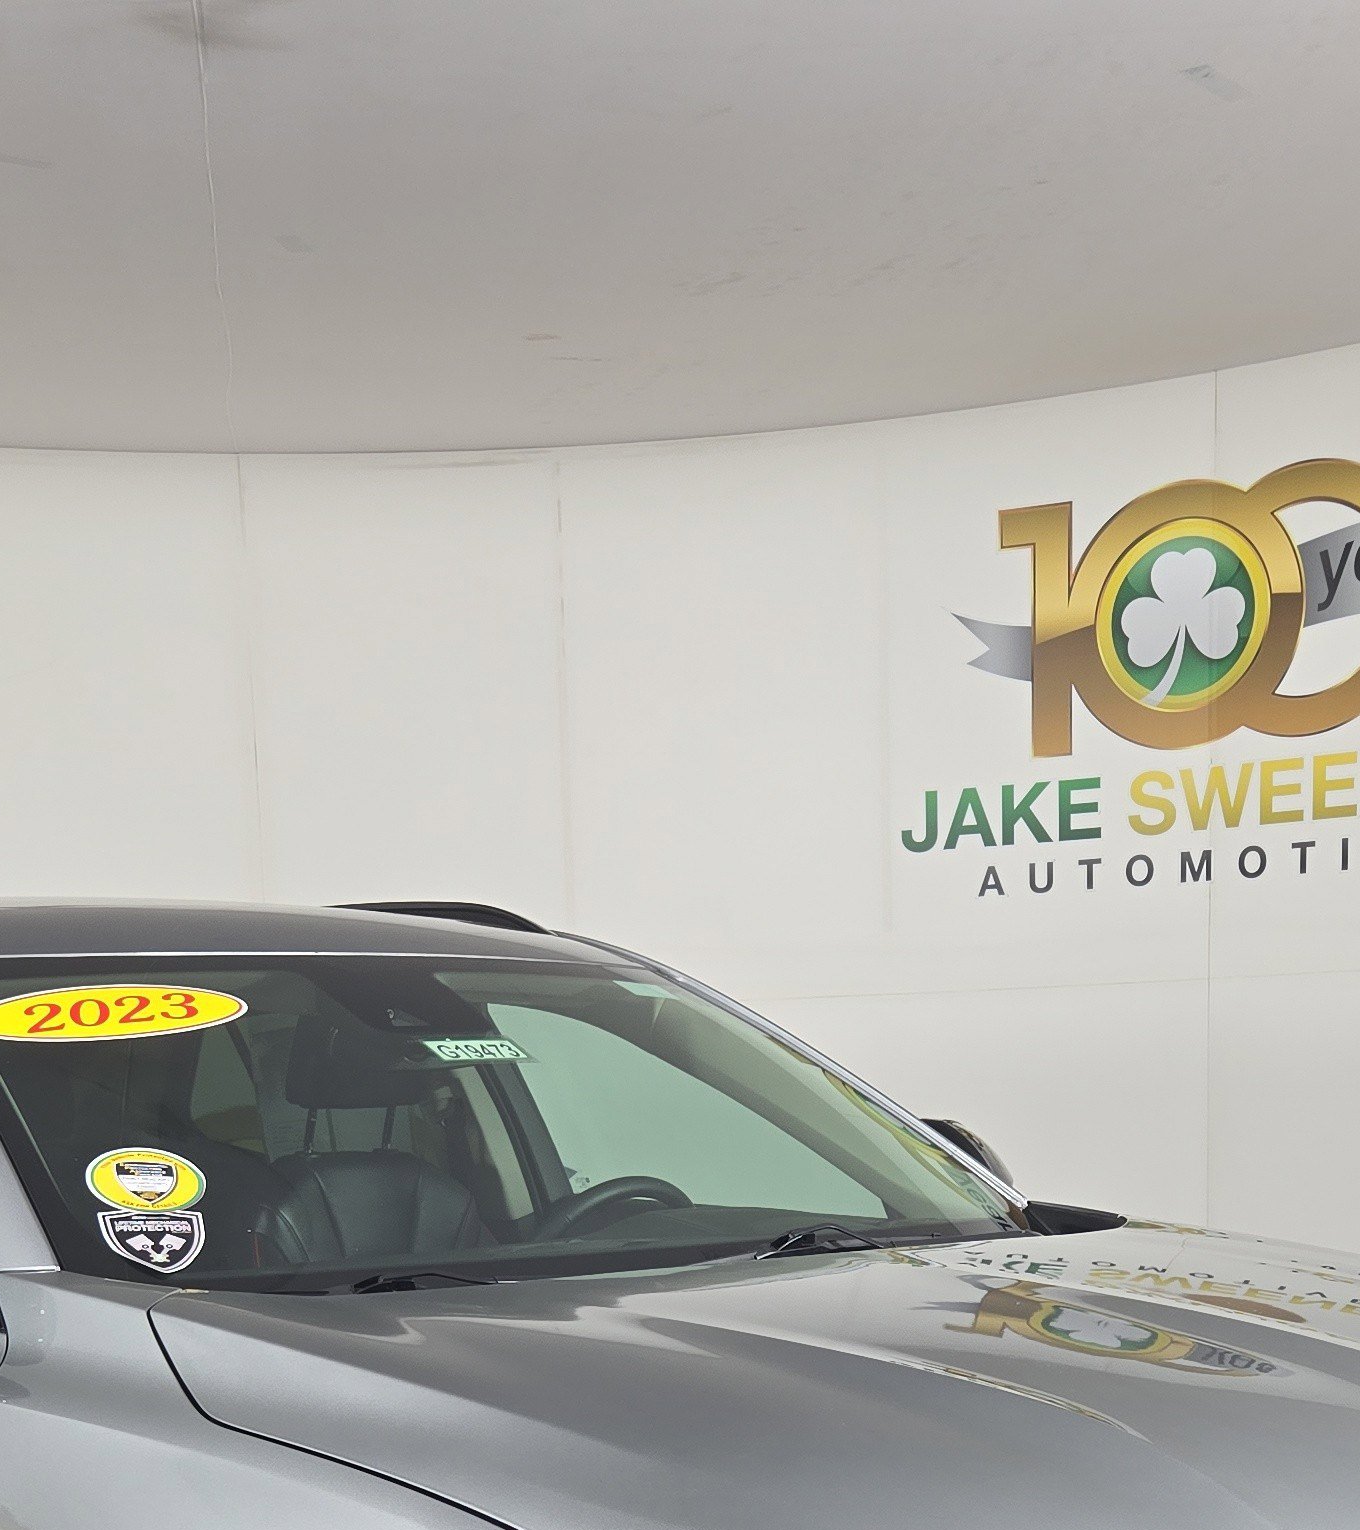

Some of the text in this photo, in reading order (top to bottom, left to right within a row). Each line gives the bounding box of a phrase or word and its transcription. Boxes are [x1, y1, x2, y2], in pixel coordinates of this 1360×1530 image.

[901, 776, 1102, 853] JAKE
[24, 993, 200, 1035] 2023
[436, 1043, 521, 1059] G19473
[115, 1224, 192, 1233] PROTECTION
